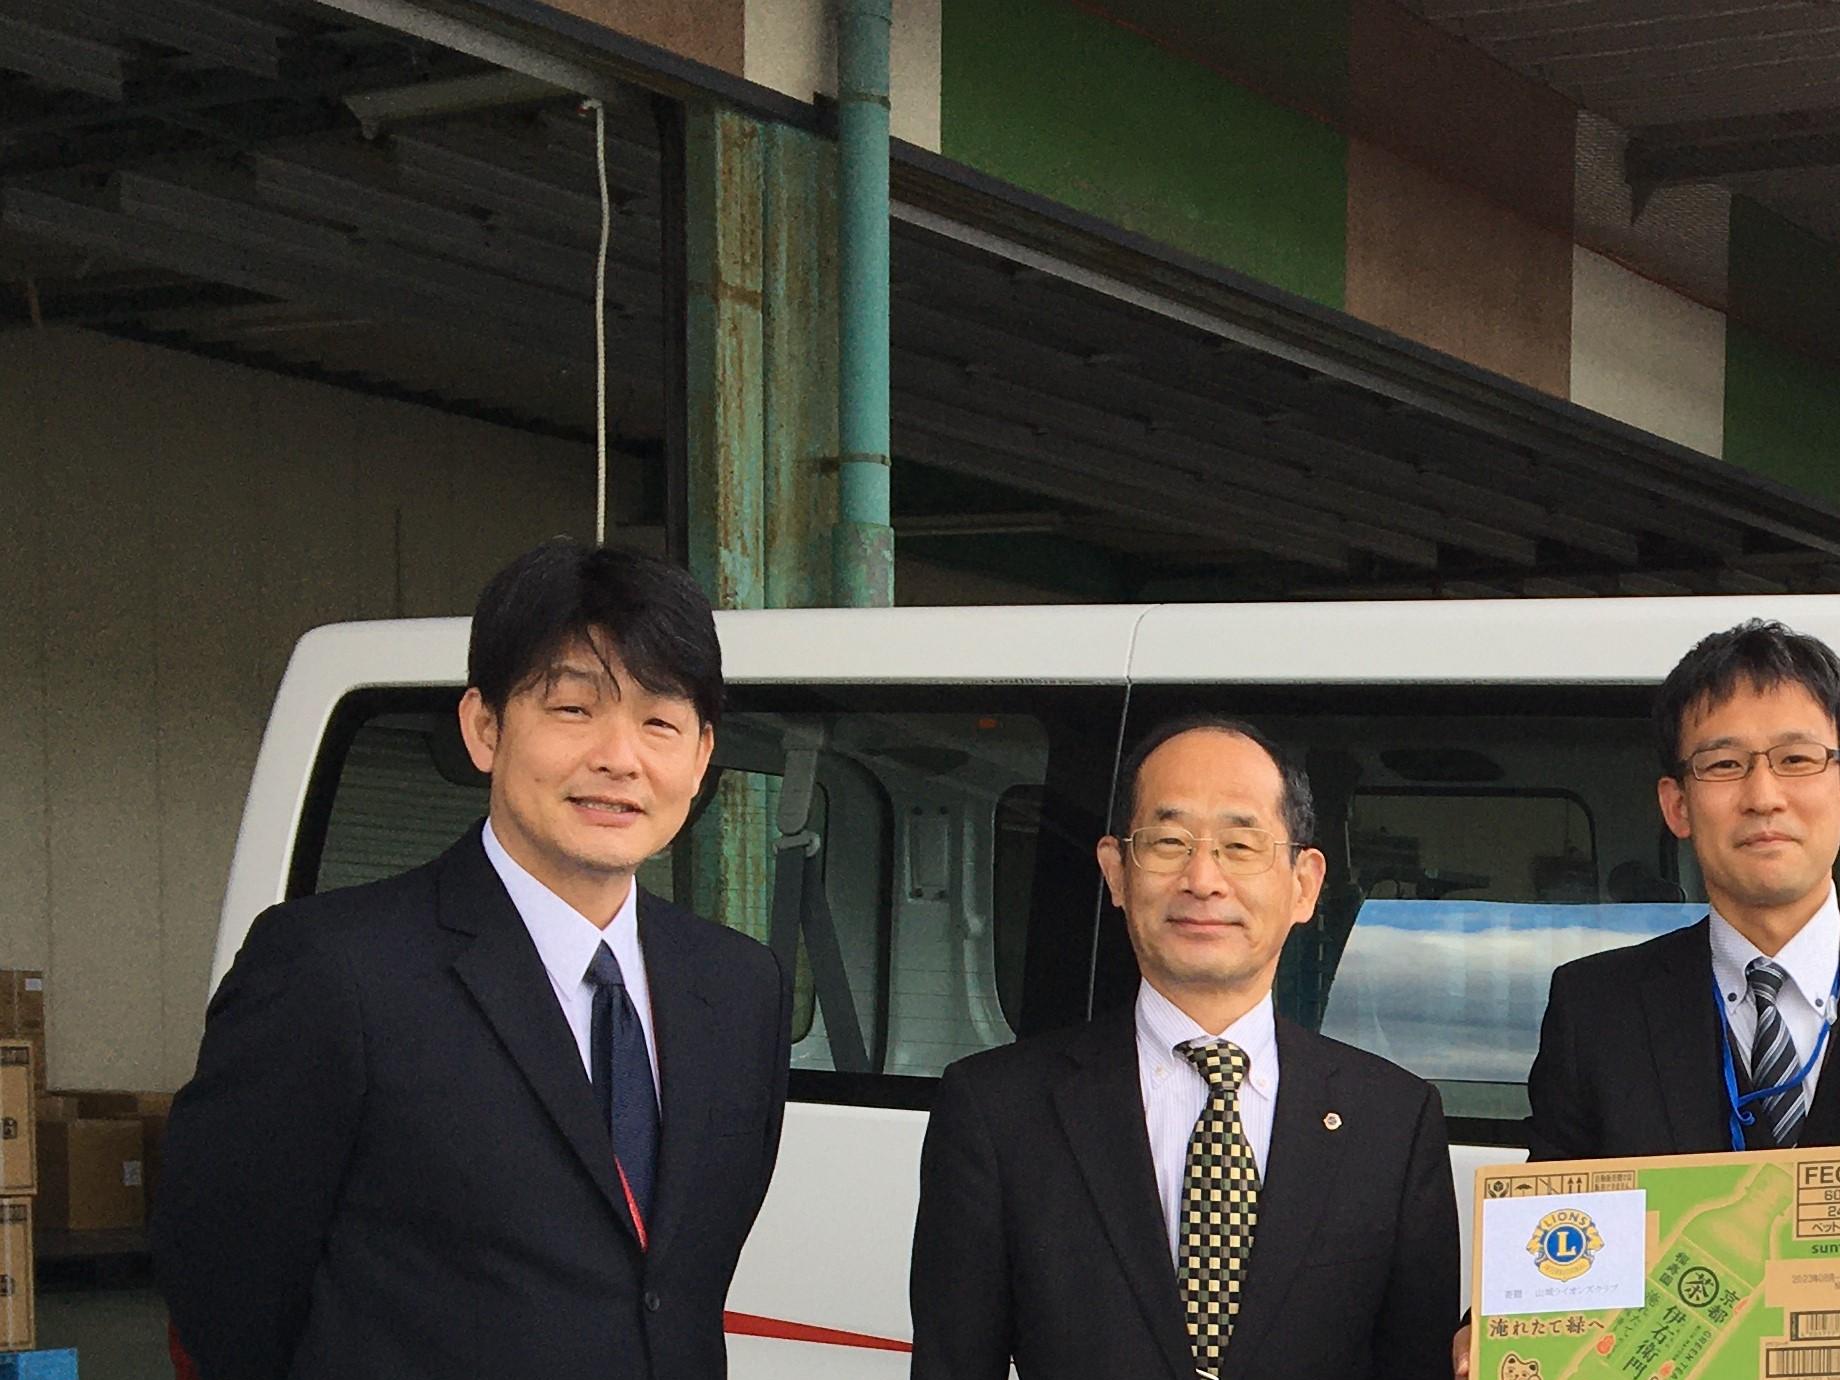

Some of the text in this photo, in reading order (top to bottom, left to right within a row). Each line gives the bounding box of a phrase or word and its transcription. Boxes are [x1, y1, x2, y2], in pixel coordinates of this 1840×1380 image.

[1544, 1211, 1588, 1228] LIONS
[1556, 1231, 1576, 1257] L
[1684, 1272, 1715, 1301] 茶
[1706, 1289, 1741, 1324] 京都
[1622, 1305, 1687, 1380] 伊右衛門
